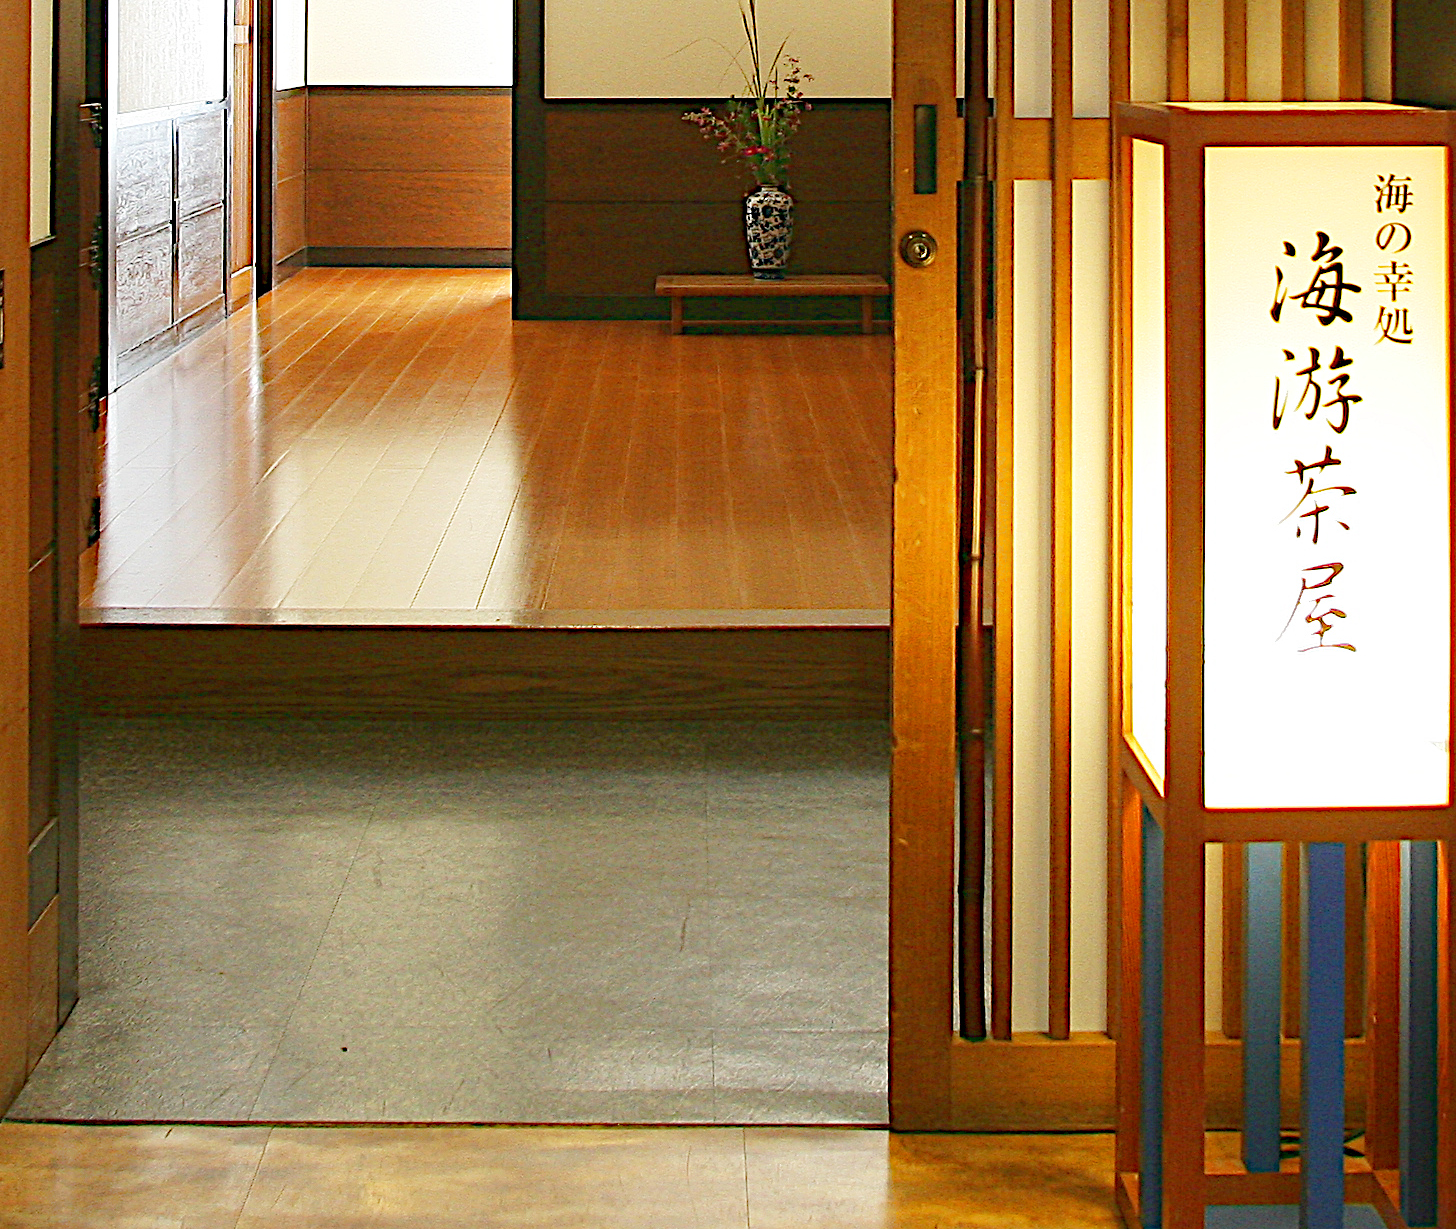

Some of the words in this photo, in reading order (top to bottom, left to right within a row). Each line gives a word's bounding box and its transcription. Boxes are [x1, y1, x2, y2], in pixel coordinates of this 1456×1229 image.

[1374, 174, 1414, 346] 海の幸処
[1270, 231, 1363, 654] 海游茶屋
